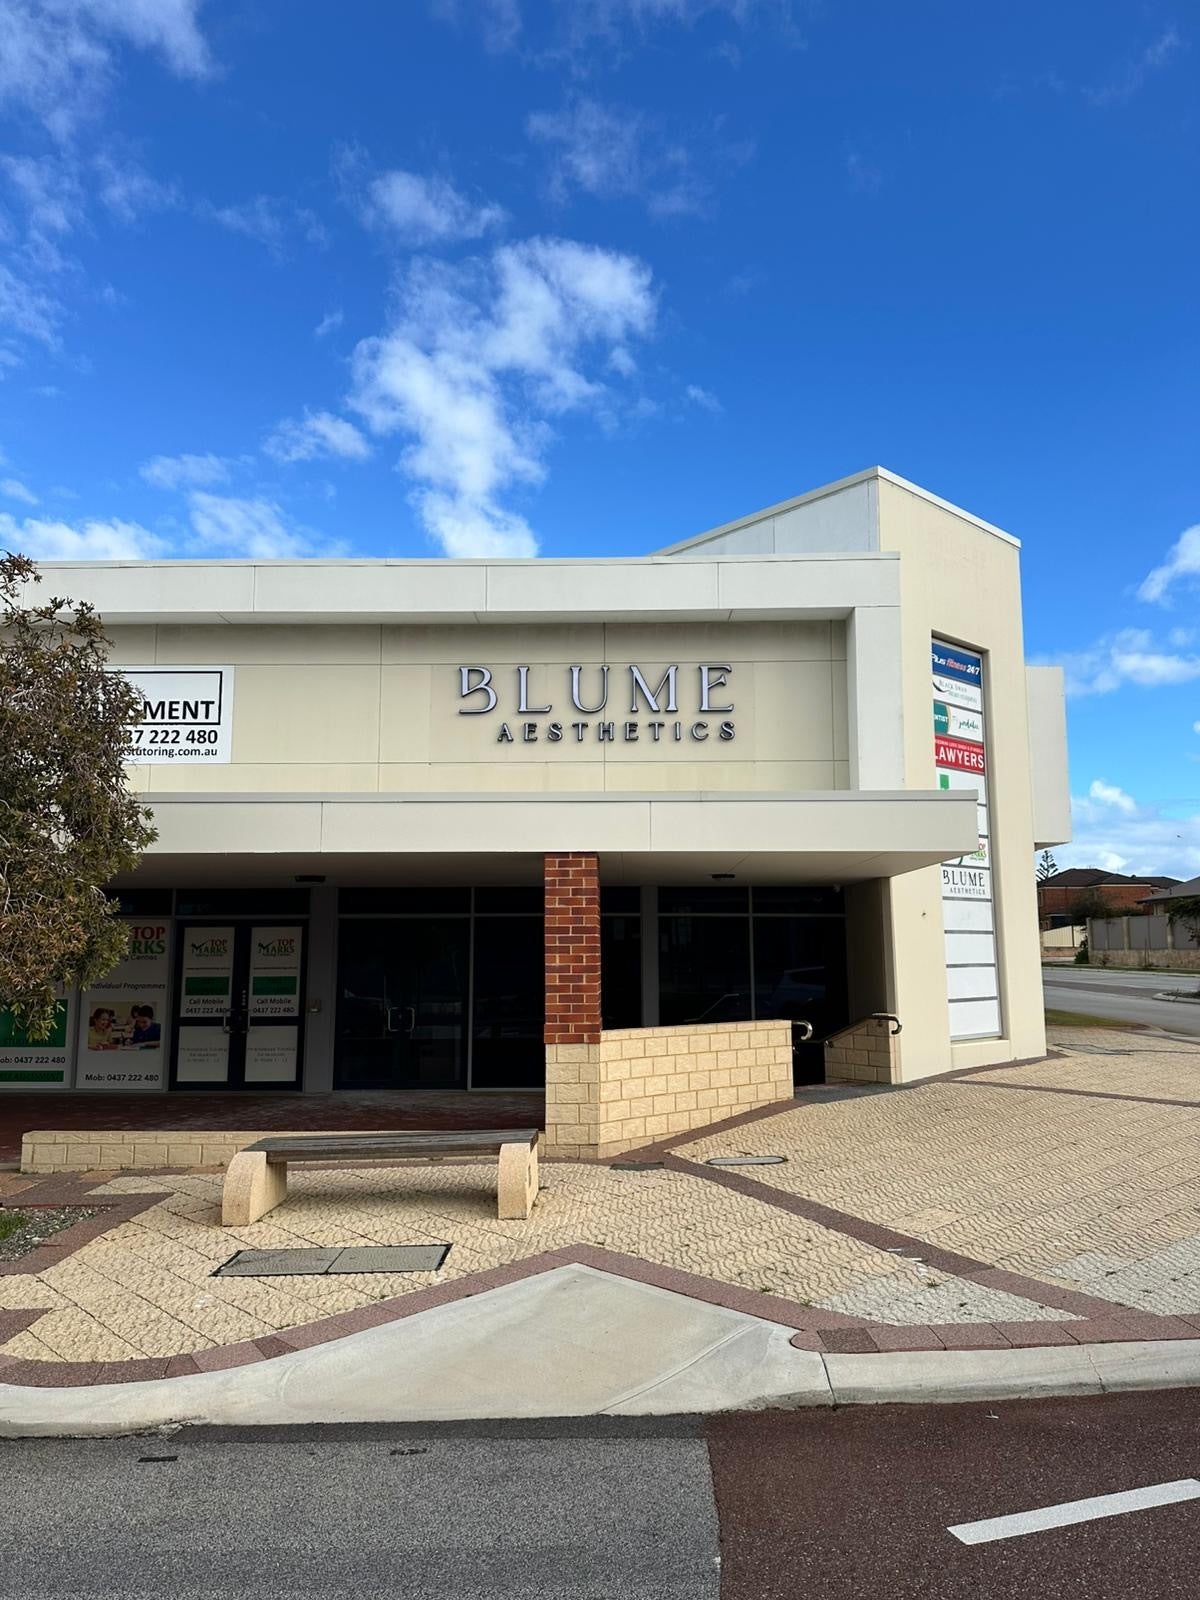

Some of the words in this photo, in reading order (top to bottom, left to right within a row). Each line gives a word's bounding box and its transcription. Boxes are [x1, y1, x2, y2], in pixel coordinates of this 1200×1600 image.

[459, 664, 734, 714] BLUME
[143, 700, 215, 720] MENT
[149, 729, 180, 744] 222
[186, 729, 218, 744] 480
[497, 721, 735, 742] AESTHETICS
[943, 869, 985, 887] BLUME
[132, 926, 165, 940] TOP
[131, 940, 165, 954] RKS
[123, 982, 166, 992] Programmes
[0, 1056, 12, 1064] ob:
[14, 1056, 33, 1064] 0437
[35, 1056, 50, 1064] 222
[52, 1056, 66, 1064] 480
[85, 1073, 105, 1081] Mob:
[106, 1073, 126, 1081] 0437
[128, 1073, 142, 1081] 222
[144, 1073, 159, 1081] 480
